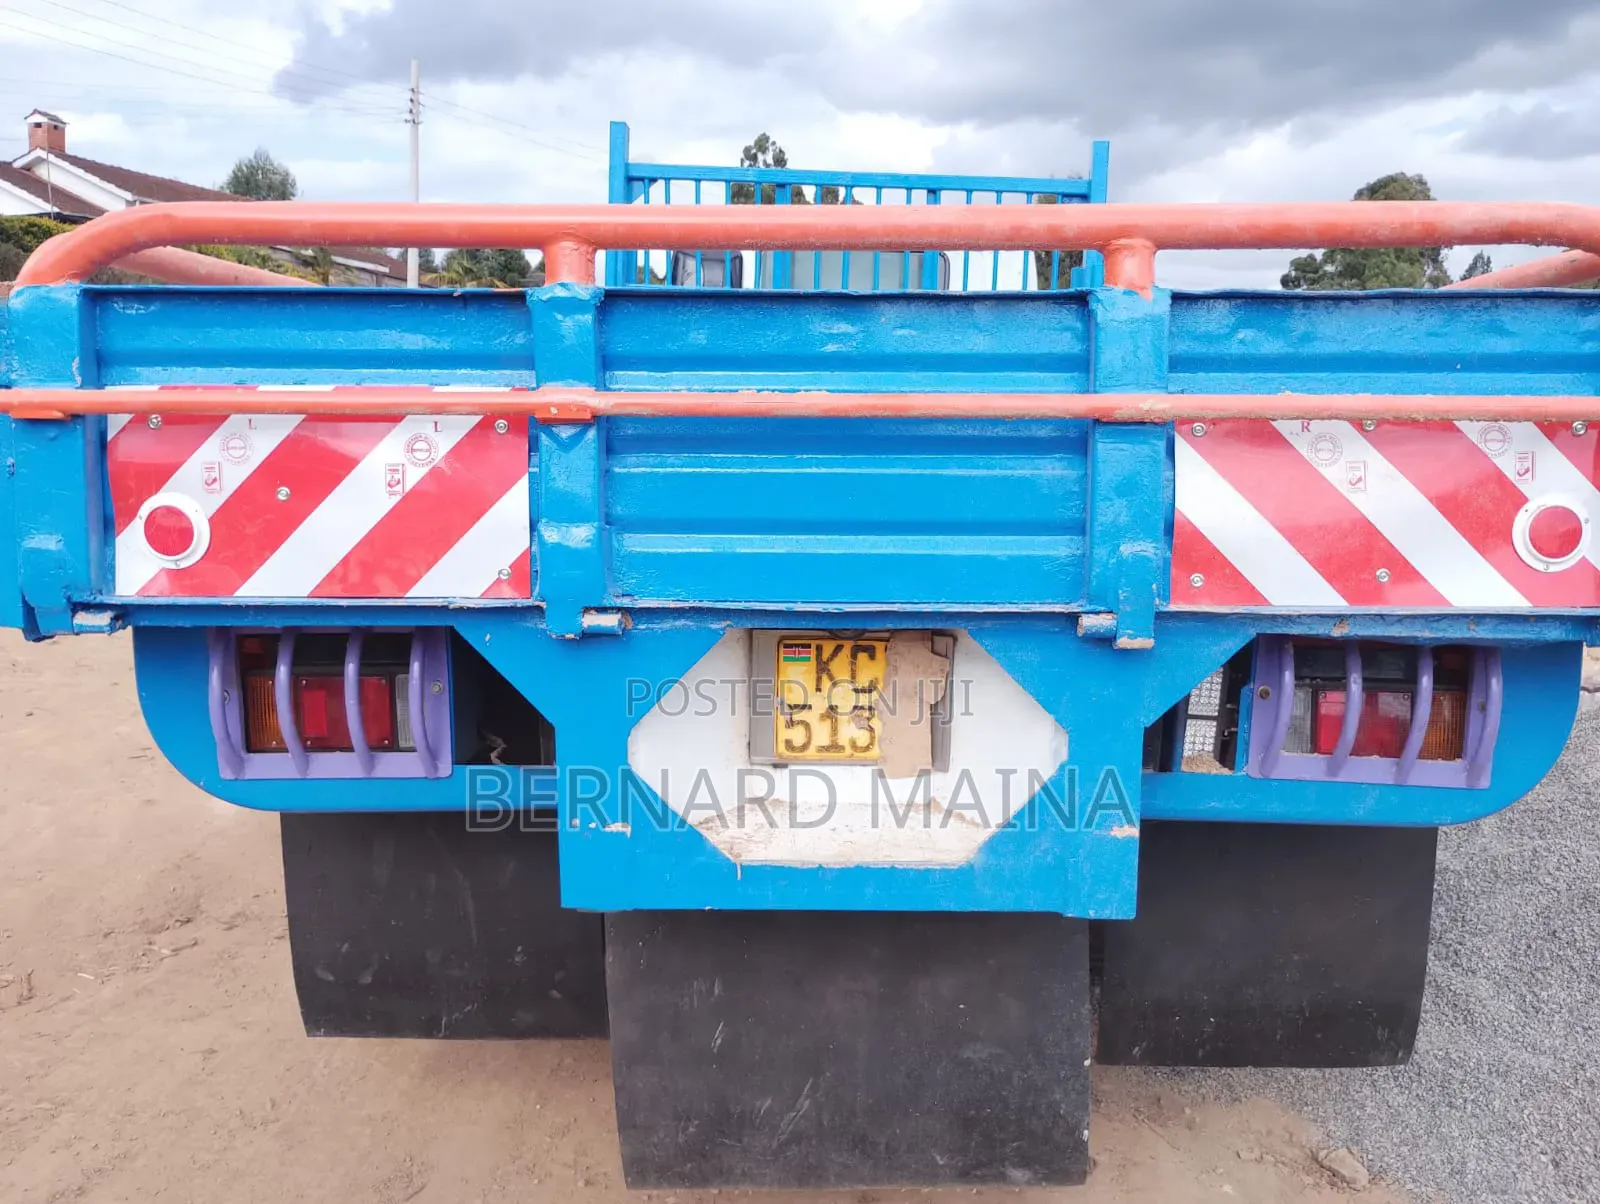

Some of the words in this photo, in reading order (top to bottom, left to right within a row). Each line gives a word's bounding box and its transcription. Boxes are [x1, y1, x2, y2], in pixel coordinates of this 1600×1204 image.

[433, 420, 443, 433] L
[1300, 420, 1311, 433] R
[815, 643, 889, 693] KC
[784, 703, 876, 754] 513
